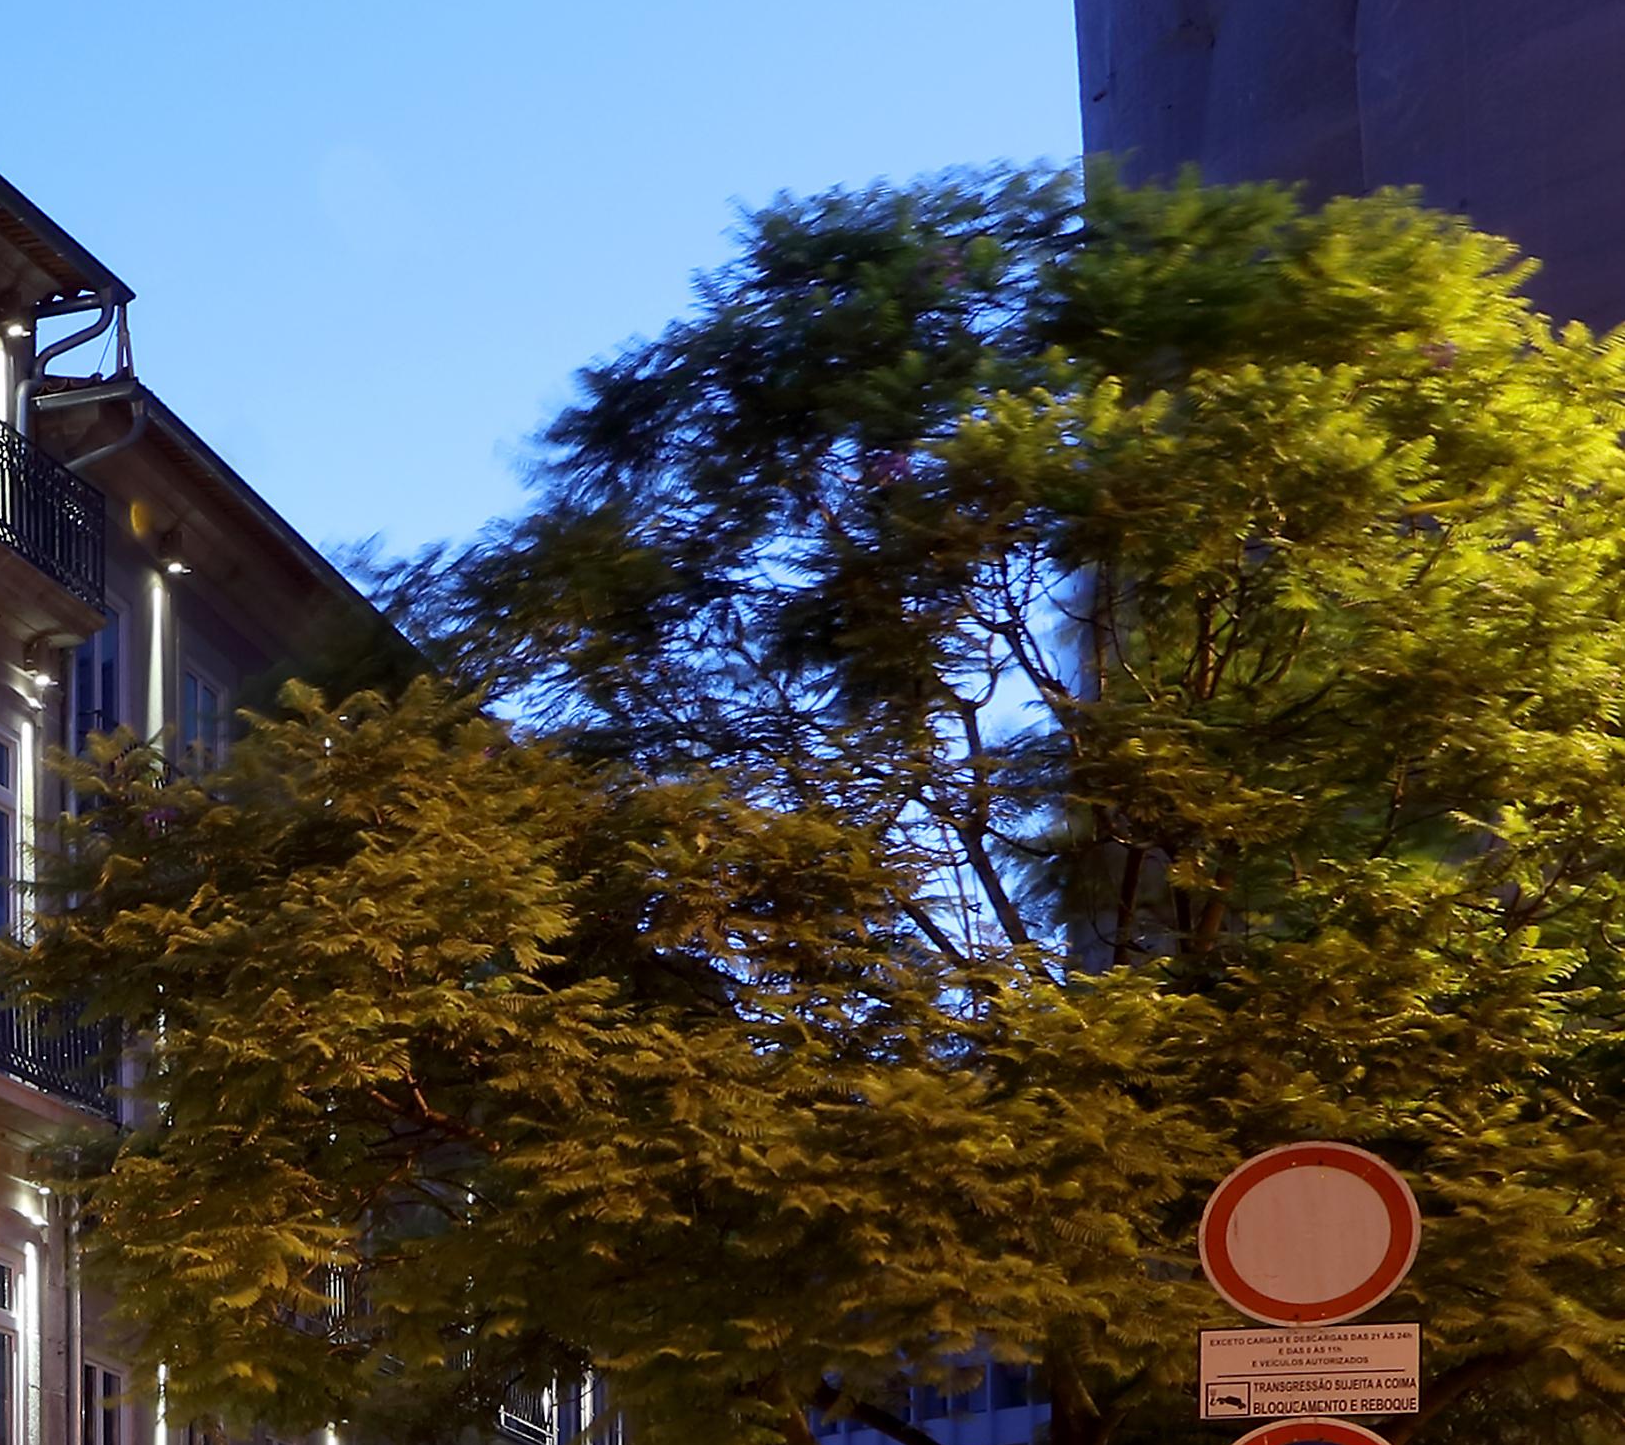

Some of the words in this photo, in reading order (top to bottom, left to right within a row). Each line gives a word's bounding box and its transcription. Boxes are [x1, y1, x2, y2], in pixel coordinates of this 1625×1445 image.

[1209, 1337, 1244, 1347] EXCETO
[1247, 1336, 1283, 1345] CARGAS
[1286, 1335, 1291, 1344] E
[1293, 1333, 1349, 1343] DESCARGAS
[1351, 1333, 1370, 1342] DAS
[1278, 1347, 1284, 1355] E
[1285, 1346, 1305, 1355] DAS
[1252, 1359, 1257, 1368] E
[1259, 1357, 1304, 1367] VEÍCULOS
[1305, 1356, 1368, 1366] AUTORIZADOS
[1254, 1377, 1332, 1393] TRANSGRESSÃO
[1335, 1378, 1373, 1390] SUJEITA
[1375, 1379, 1383, 1389] A
[1385, 1377, 1416, 1389] COIMA
[1253, 1399, 1347, 1415] BLOQUEAMENTO
[1350, 1399, 1357, 1411] E
[1361, 1397, 1416, 1411] REBOQUE
